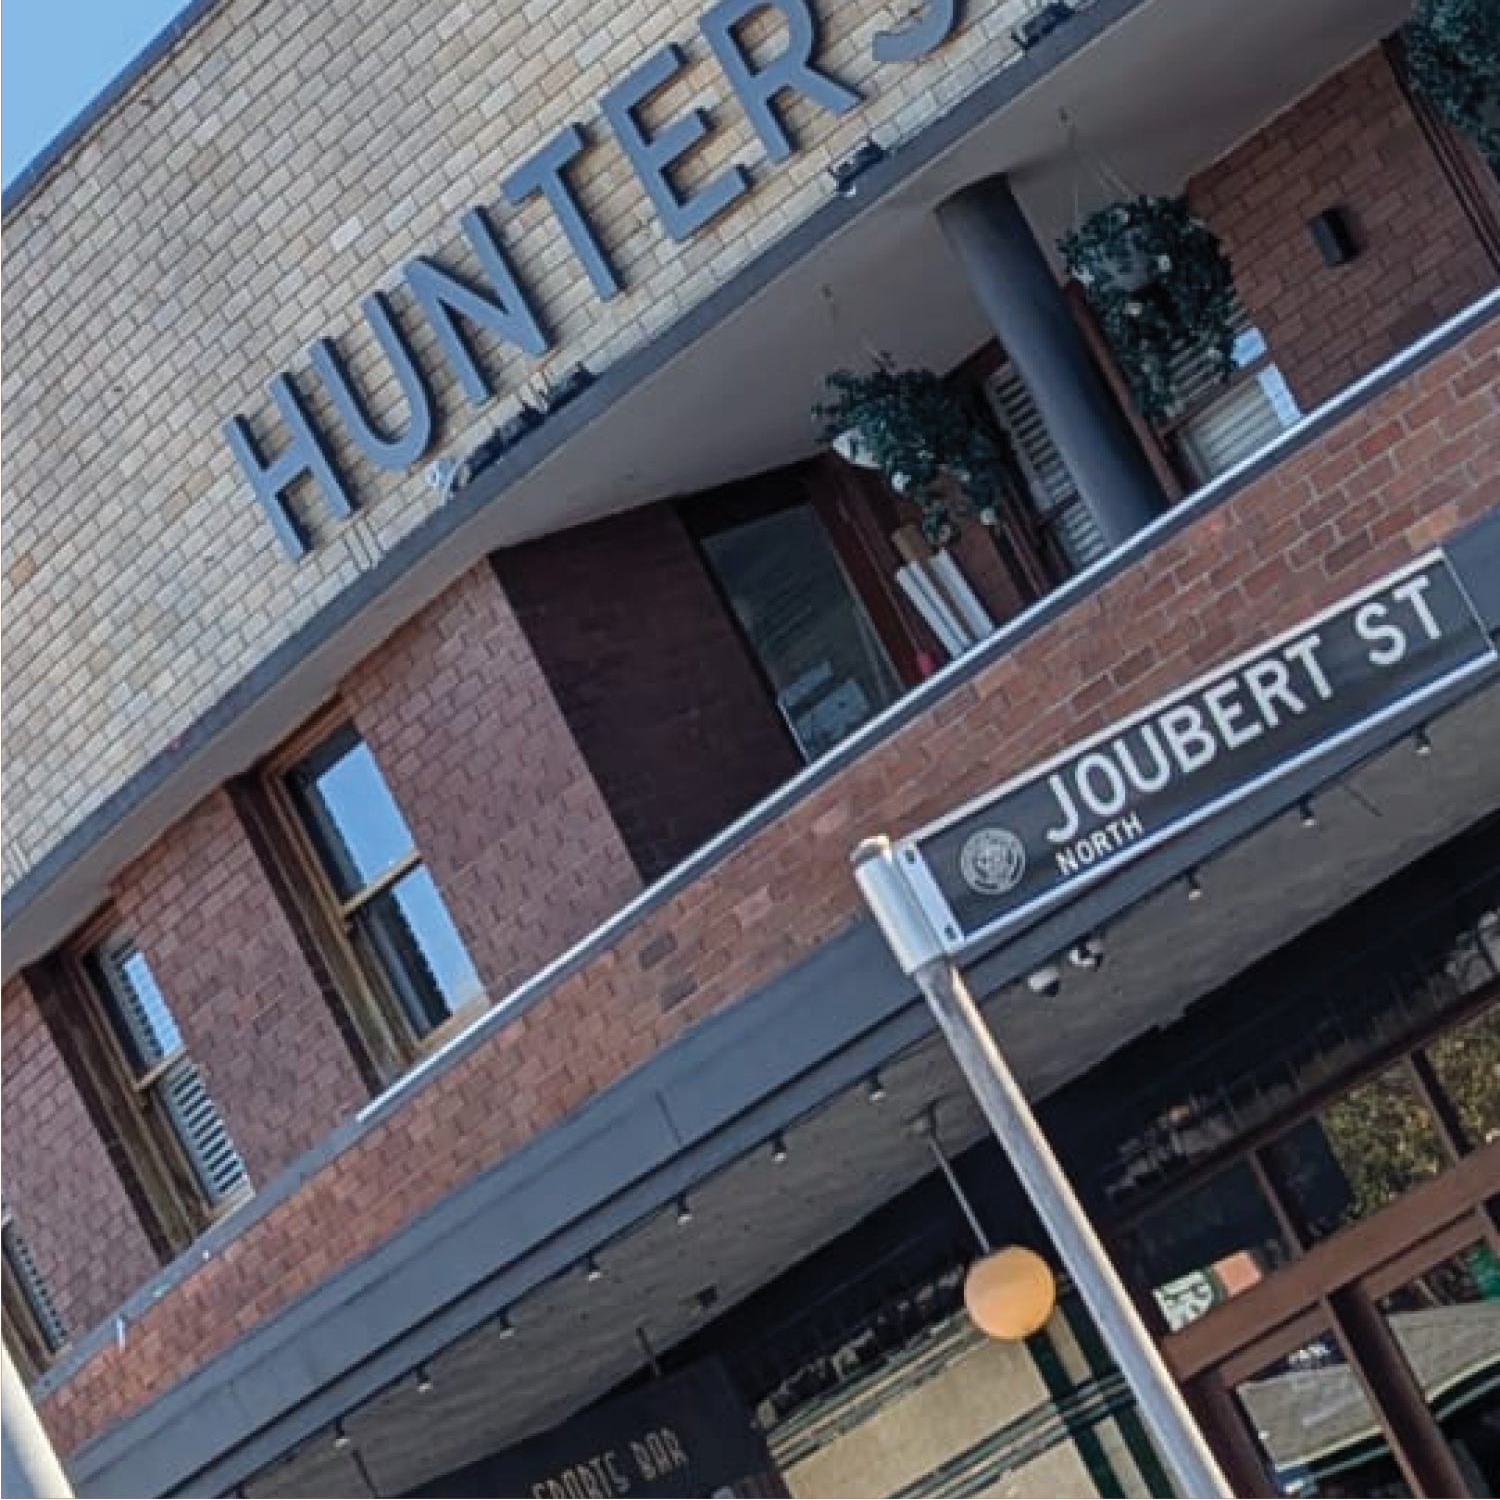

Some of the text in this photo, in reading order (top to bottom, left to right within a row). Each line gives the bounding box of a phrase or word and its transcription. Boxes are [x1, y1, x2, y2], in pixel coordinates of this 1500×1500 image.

[1046, 574, 1442, 844] JOUBERT ST
[1055, 811, 1144, 876] NORTH
[629, 1426, 688, 1480] BAR
